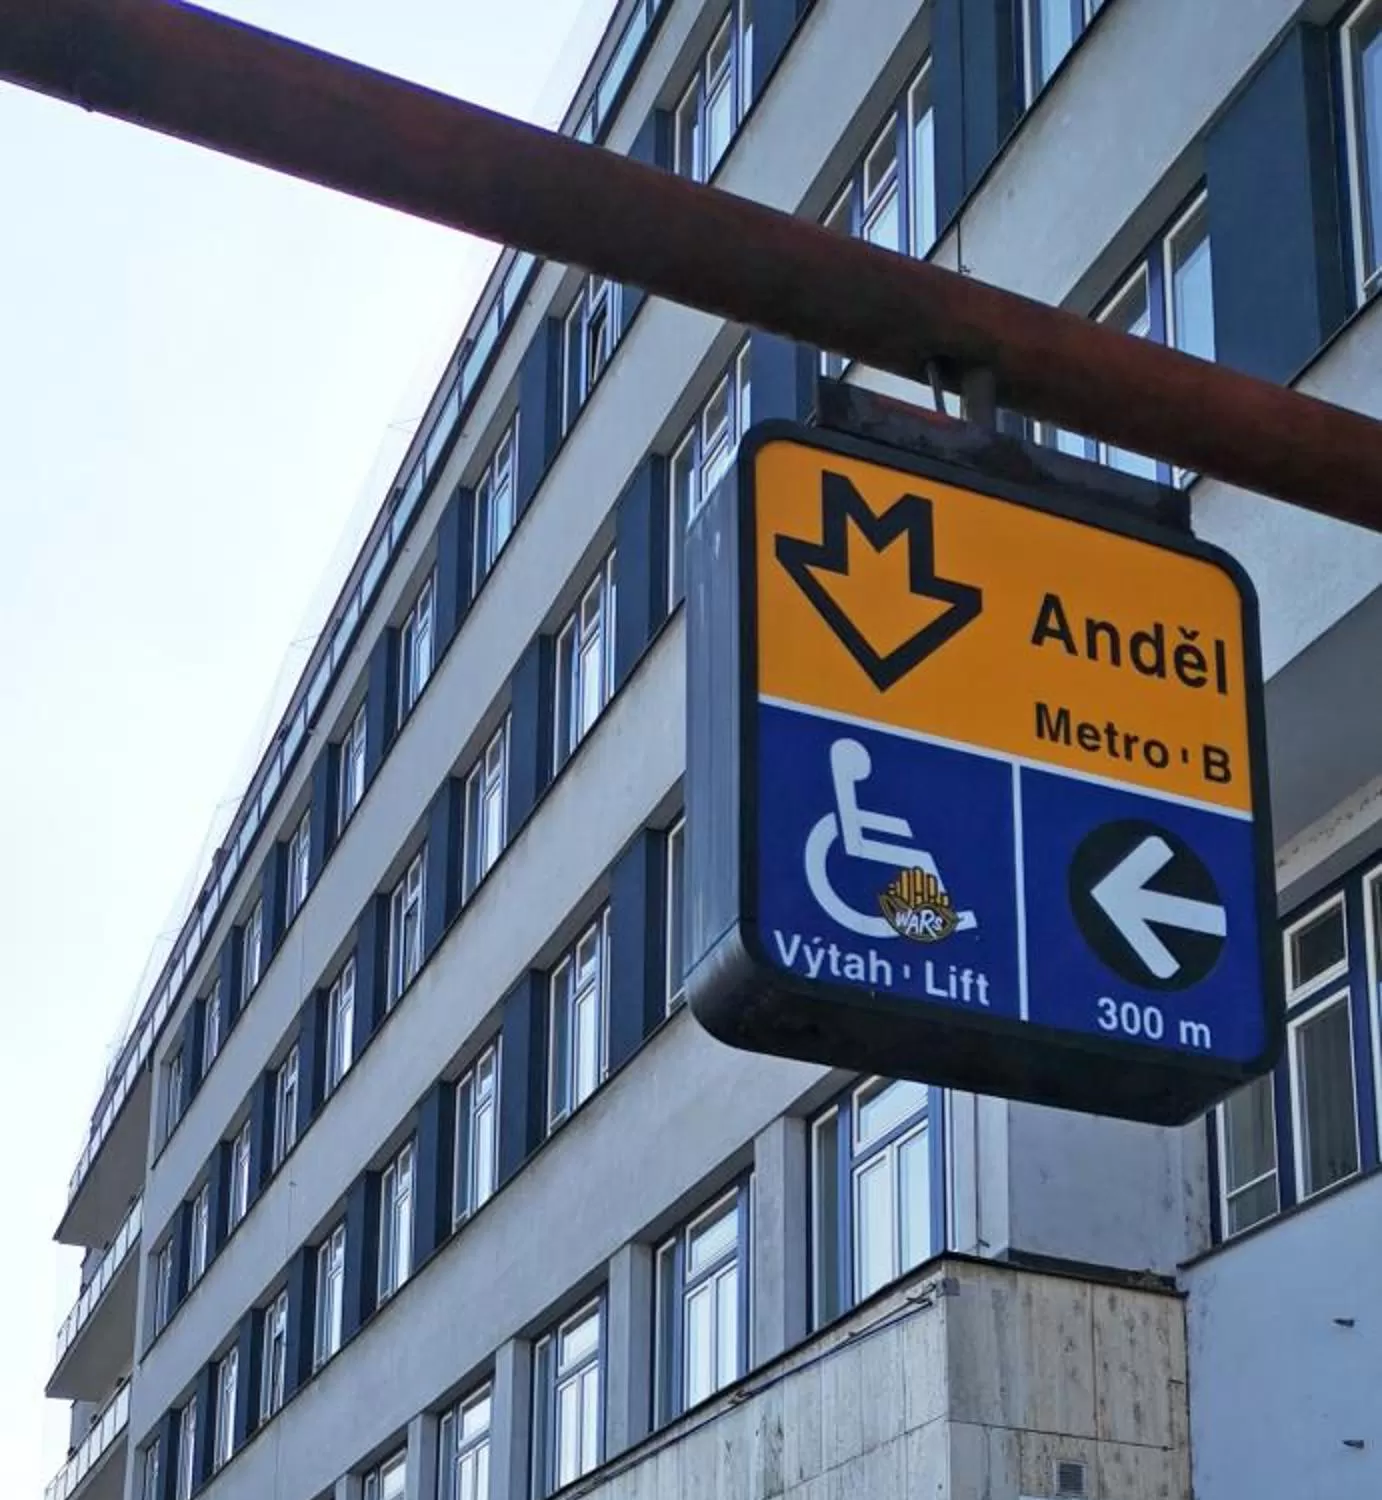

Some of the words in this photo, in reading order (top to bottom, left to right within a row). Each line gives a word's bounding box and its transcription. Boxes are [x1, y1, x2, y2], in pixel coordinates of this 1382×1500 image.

[1031, 592, 1228, 695] Anděl
[1034, 702, 1170, 769] Metro
[1203, 744, 1233, 784] B
[774, 930, 892, 986] Výtah
[925, 960, 990, 1007] Lift
[1097, 997, 1164, 1040] 300
[1179, 1019, 1211, 1049] m
